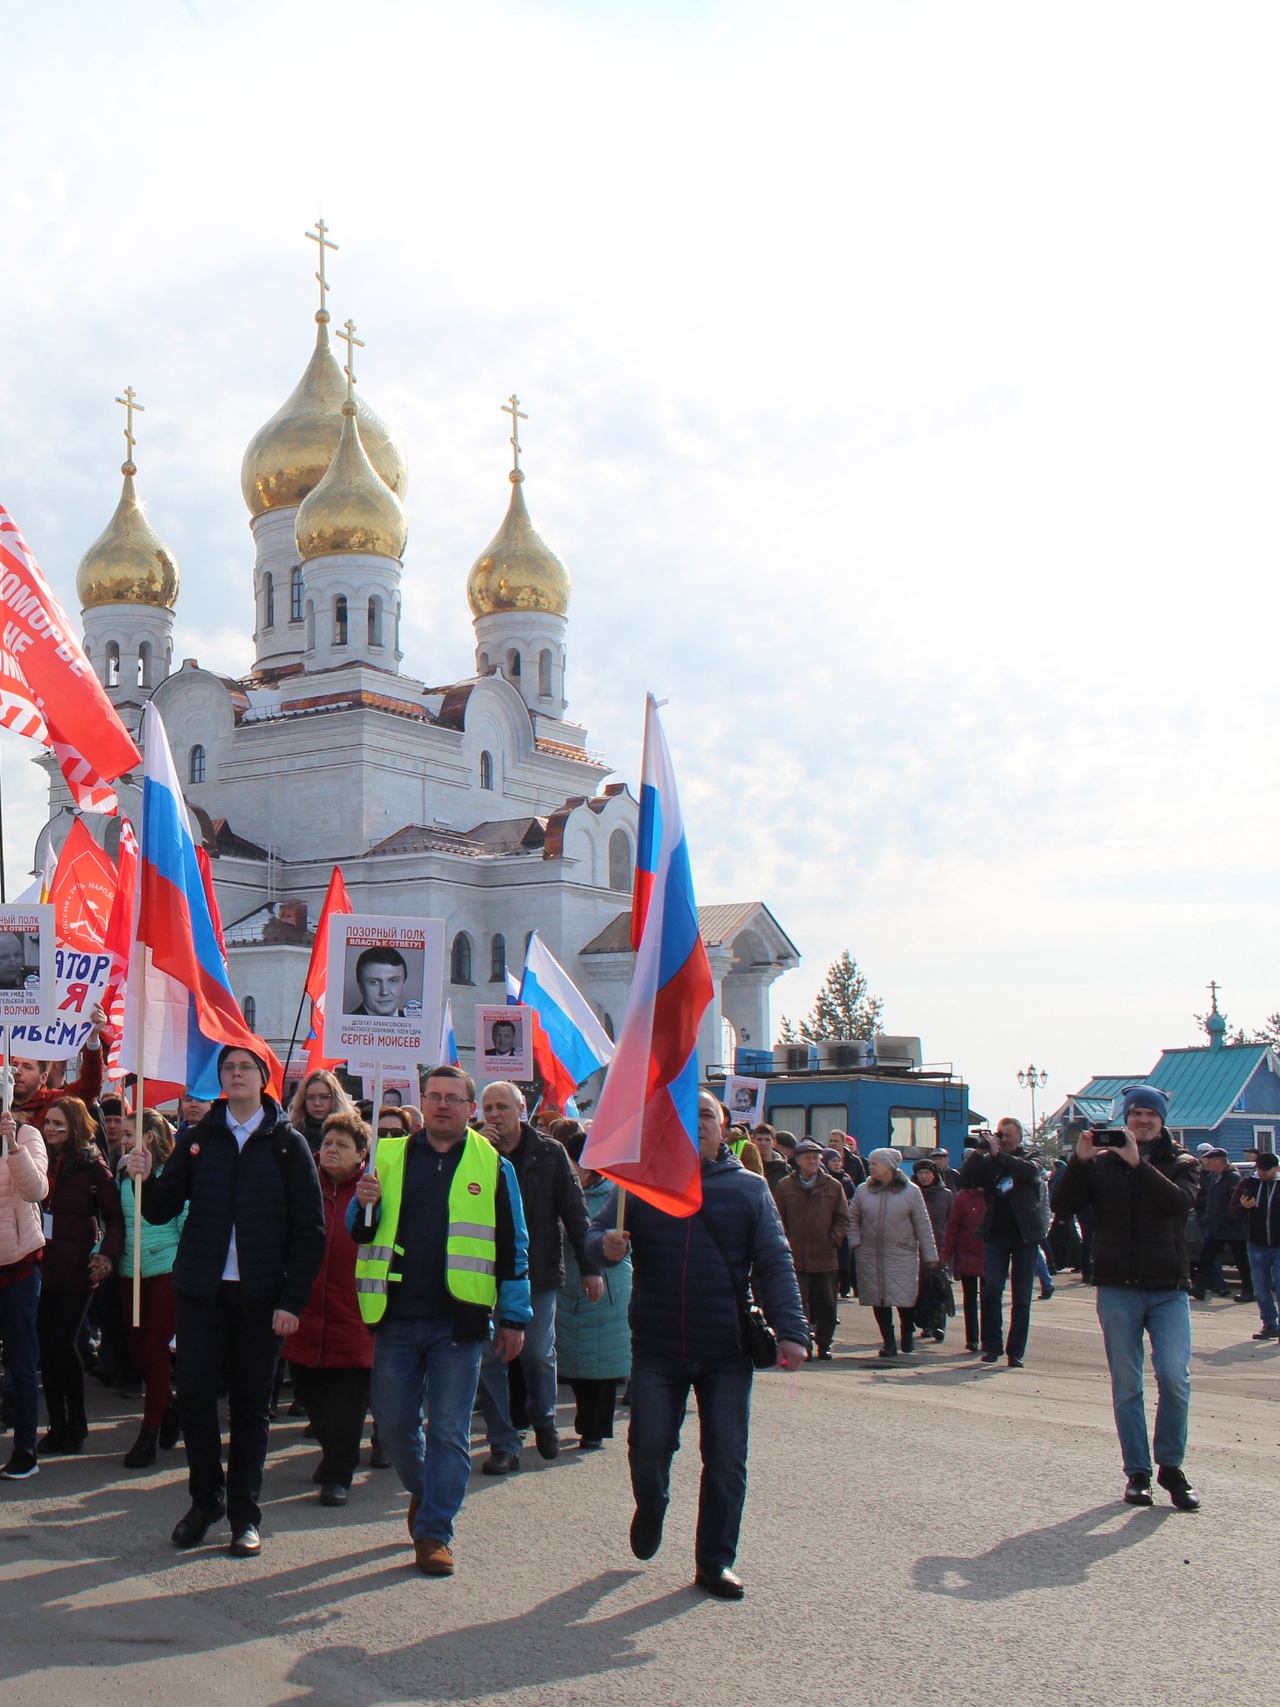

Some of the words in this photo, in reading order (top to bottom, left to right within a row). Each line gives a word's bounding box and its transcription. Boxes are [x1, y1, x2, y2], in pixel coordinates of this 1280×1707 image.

[3, 621, 34, 662] НЕ
[19, 916, 40, 924] ПОЛК
[346, 926, 397, 938] ПОЗОРНЫЙ
[400, 929, 426, 940] ПОЛК
[389, 940, 422, 948] ОТВЕТУ!
[55, 950, 110, 988] АТОР,
[4, 1005, 40, 1015] ВОЛЧКОВ
[341, 1034, 375, 1046] СЕРГЕЙ
[377, 1036, 421, 1047] МОИСЕЕВ
